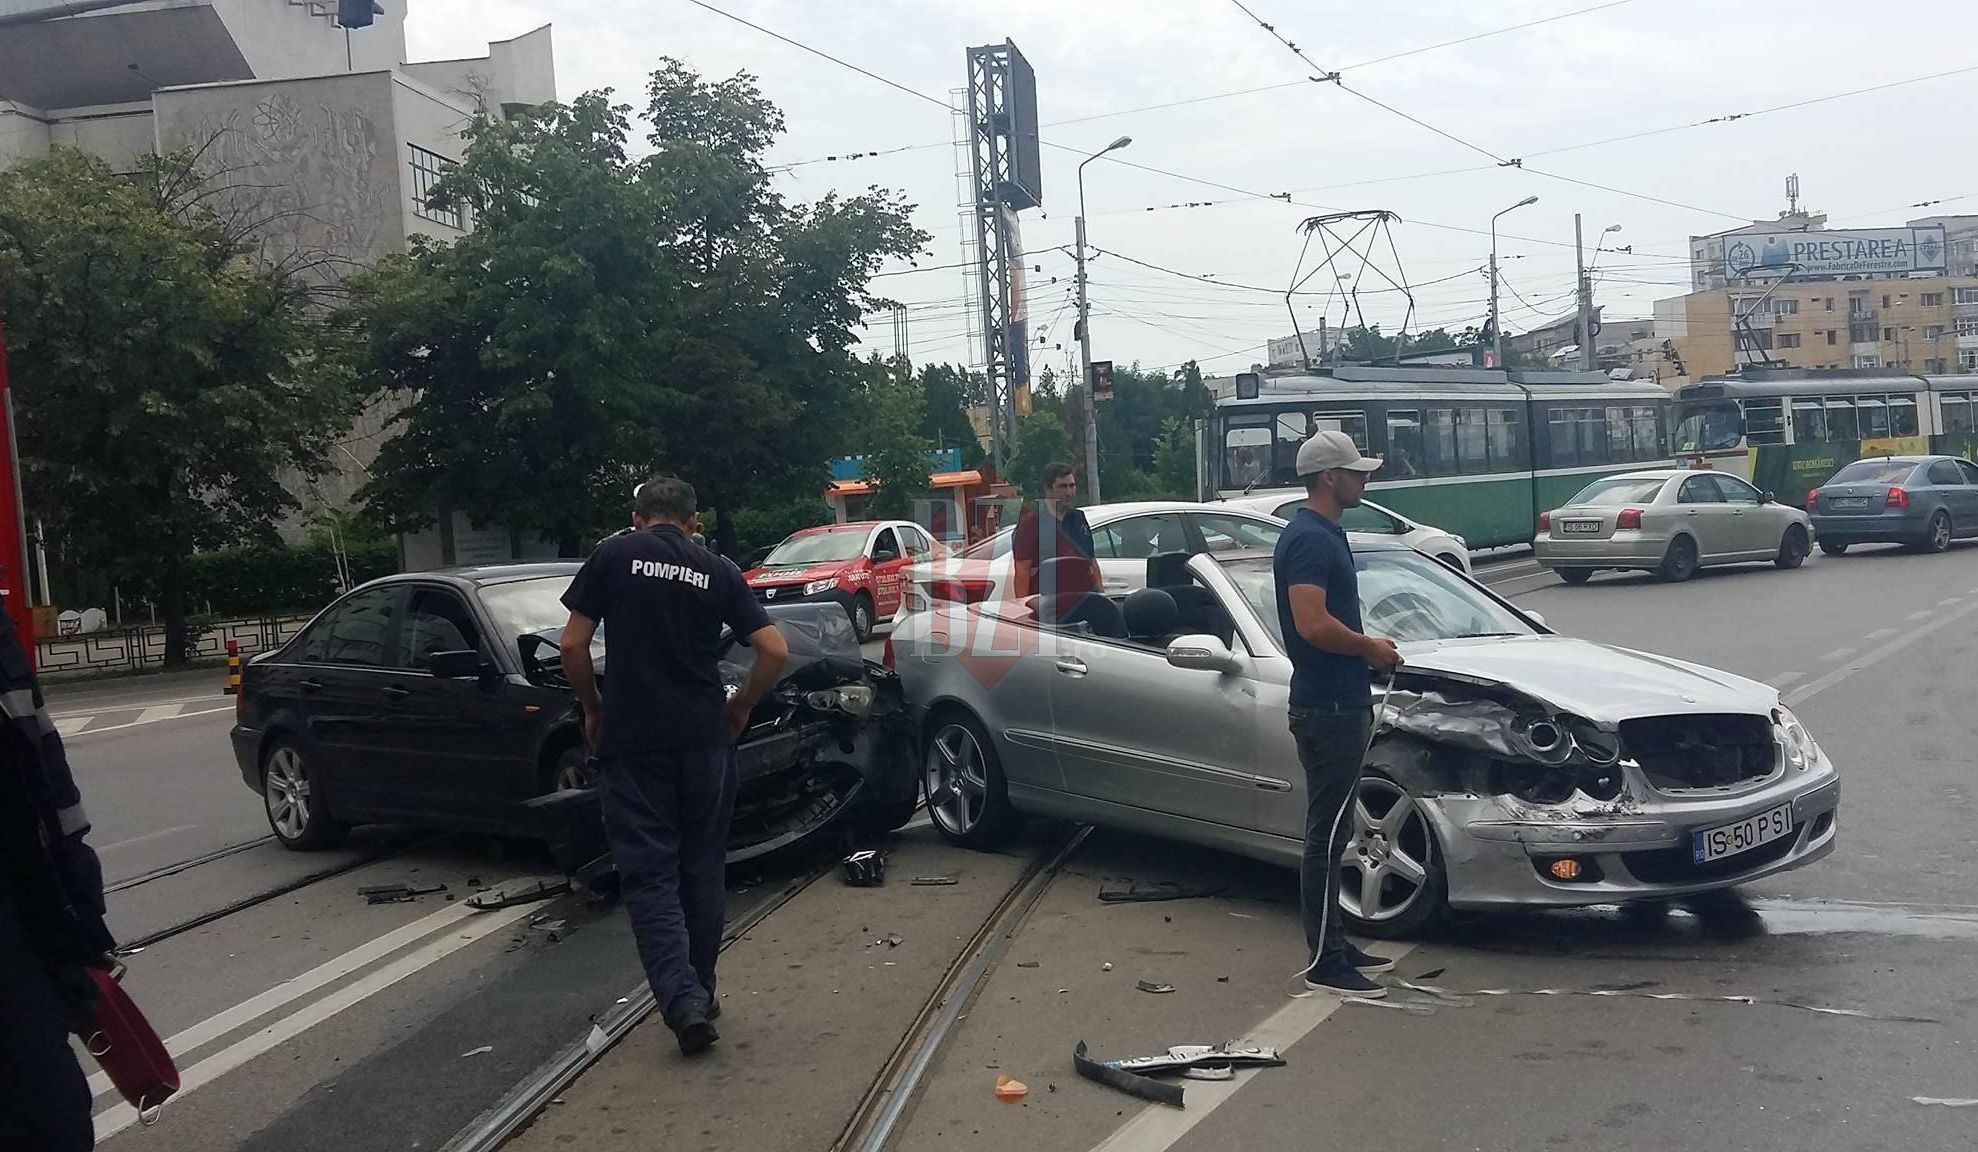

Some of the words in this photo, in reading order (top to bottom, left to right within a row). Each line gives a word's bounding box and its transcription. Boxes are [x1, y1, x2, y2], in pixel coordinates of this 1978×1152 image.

[1794, 238, 1908, 262] PRESTAREA
[631, 559, 710, 590] POMPIERI
[1707, 830, 1728, 857] IS
[1733, 822, 1754, 850] 50
[1758, 807, 1790, 842] PSI
